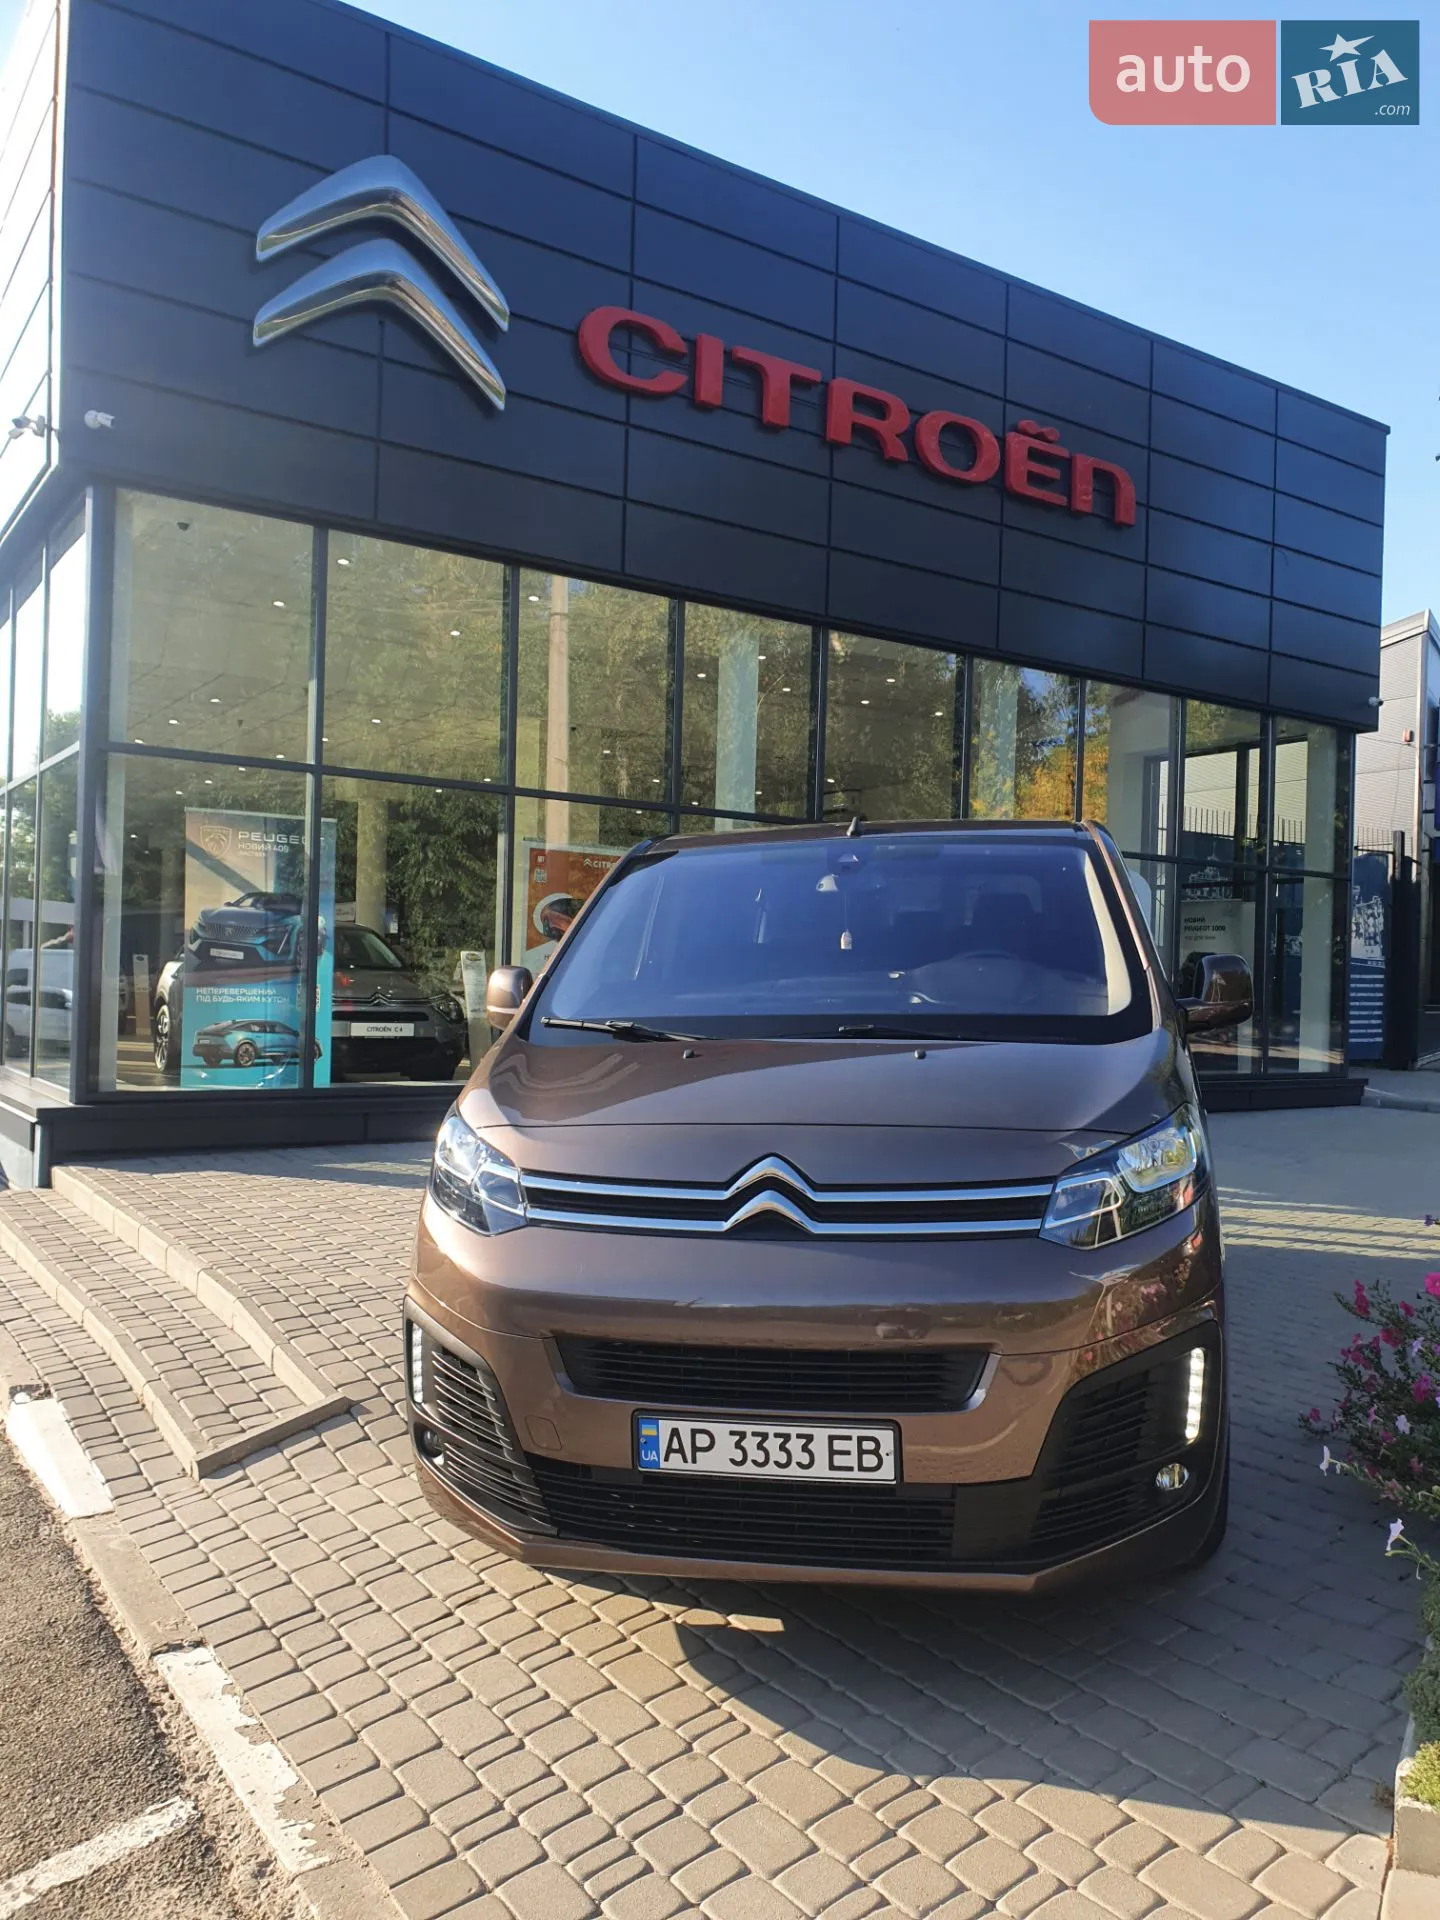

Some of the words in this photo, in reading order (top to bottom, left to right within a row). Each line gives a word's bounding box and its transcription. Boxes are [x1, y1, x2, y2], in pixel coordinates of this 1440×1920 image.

[238, 830, 324, 845] PEUGE
[641, 1449, 658, 1462] UA
[663, 1427, 716, 1465] AP
[728, 1430, 815, 1470] 3333
[828, 1434, 884, 1473] EB
